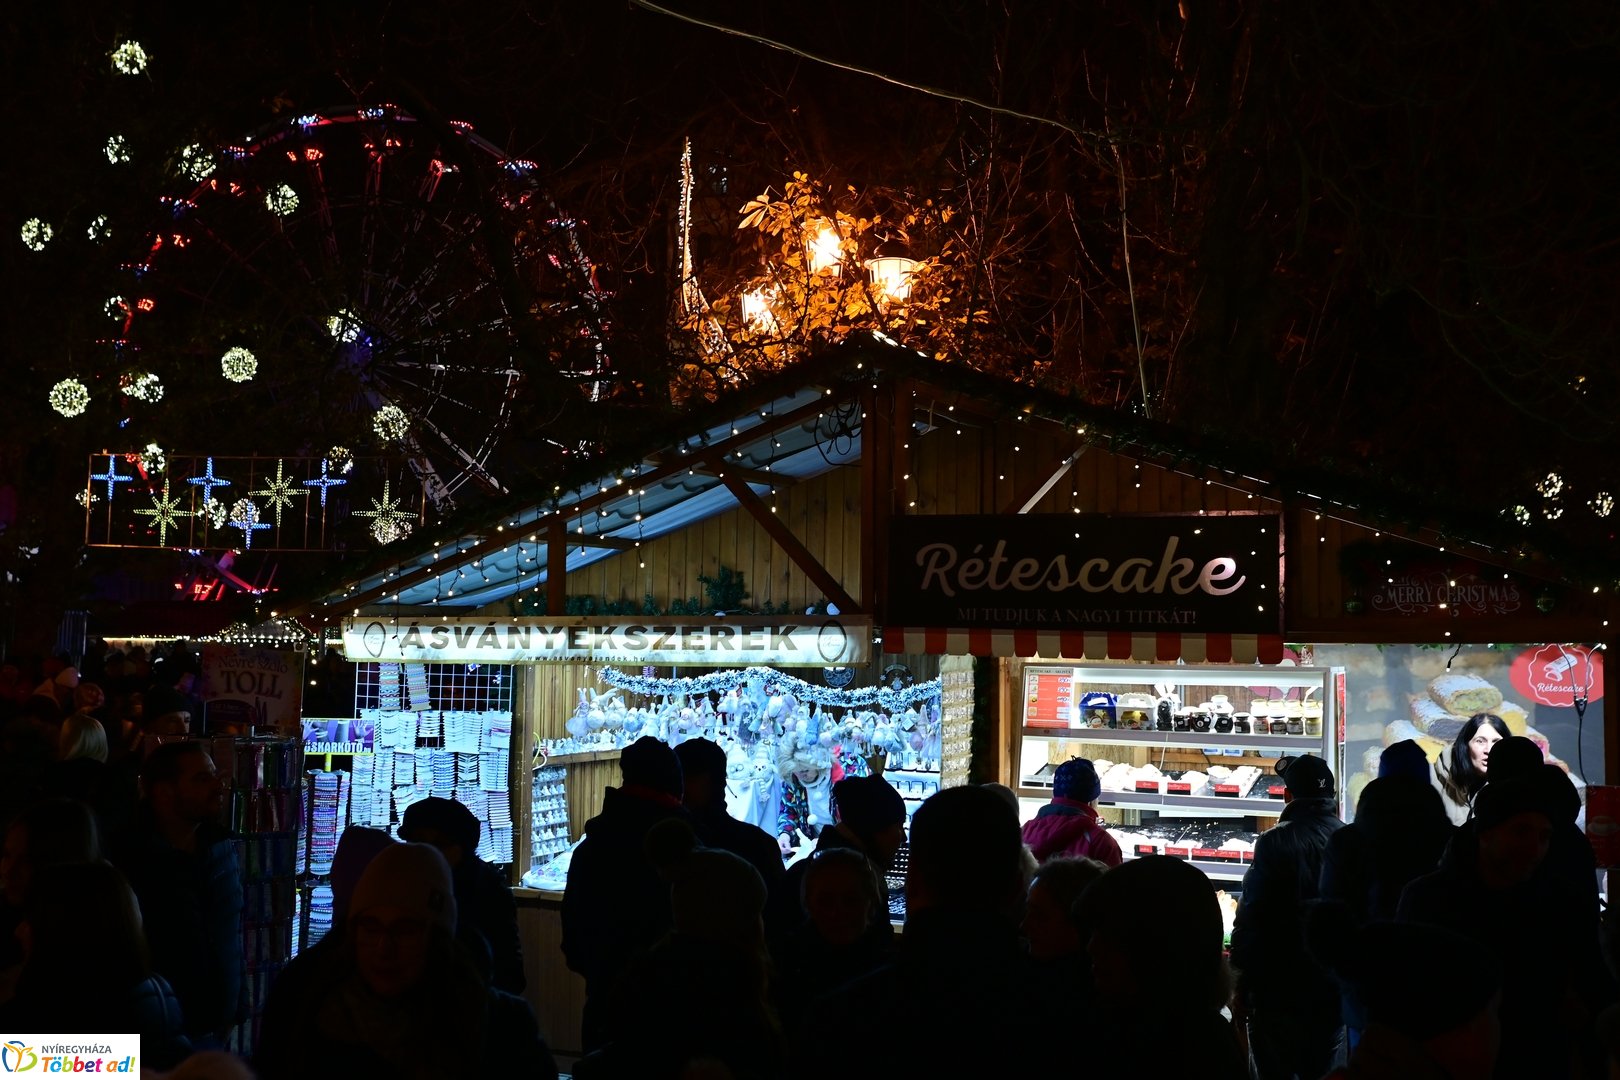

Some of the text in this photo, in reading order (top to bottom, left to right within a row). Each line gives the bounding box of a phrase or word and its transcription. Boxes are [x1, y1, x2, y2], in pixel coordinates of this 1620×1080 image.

[914, 535, 1246, 599] Rétescake
[1386, 583, 1520, 604] MERRY CHRISTMAS
[957, 608, 1197, 625] MI TUDJUK A NAGYI TITKÁT!
[220, 670, 282, 699] TOLL
[1537, 683, 1585, 693] Rétescake
